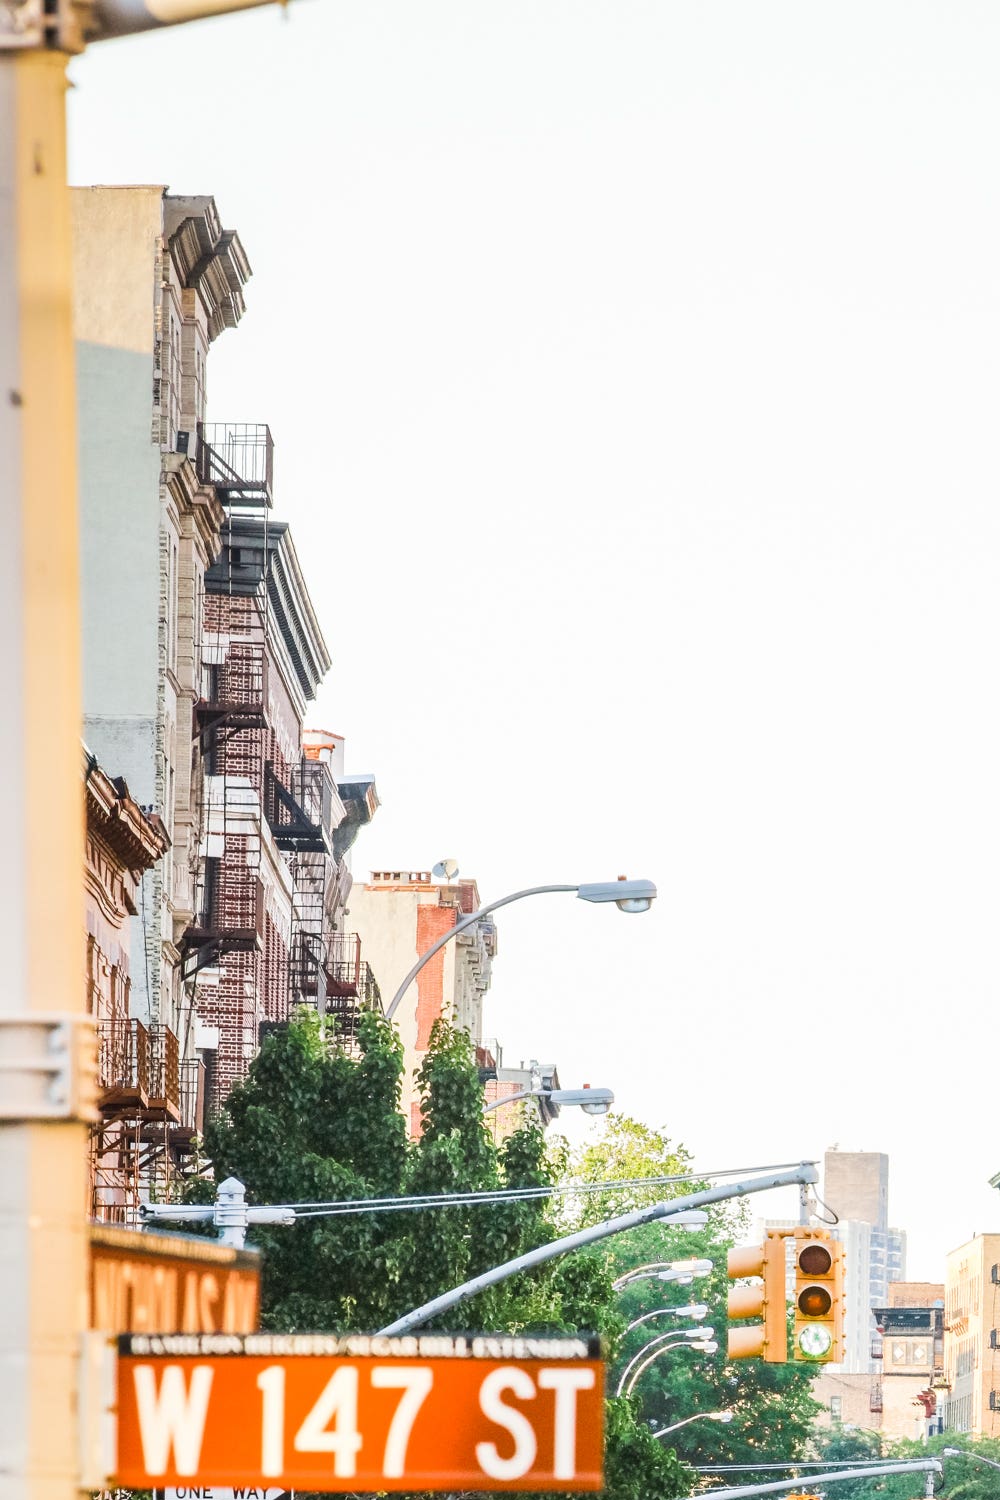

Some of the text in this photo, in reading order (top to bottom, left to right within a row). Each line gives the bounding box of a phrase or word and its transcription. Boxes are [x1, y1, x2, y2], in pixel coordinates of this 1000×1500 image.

[132, 1364, 596, 1480] W 147 ST
[175, 1486, 270, 1499] ONE WAY
